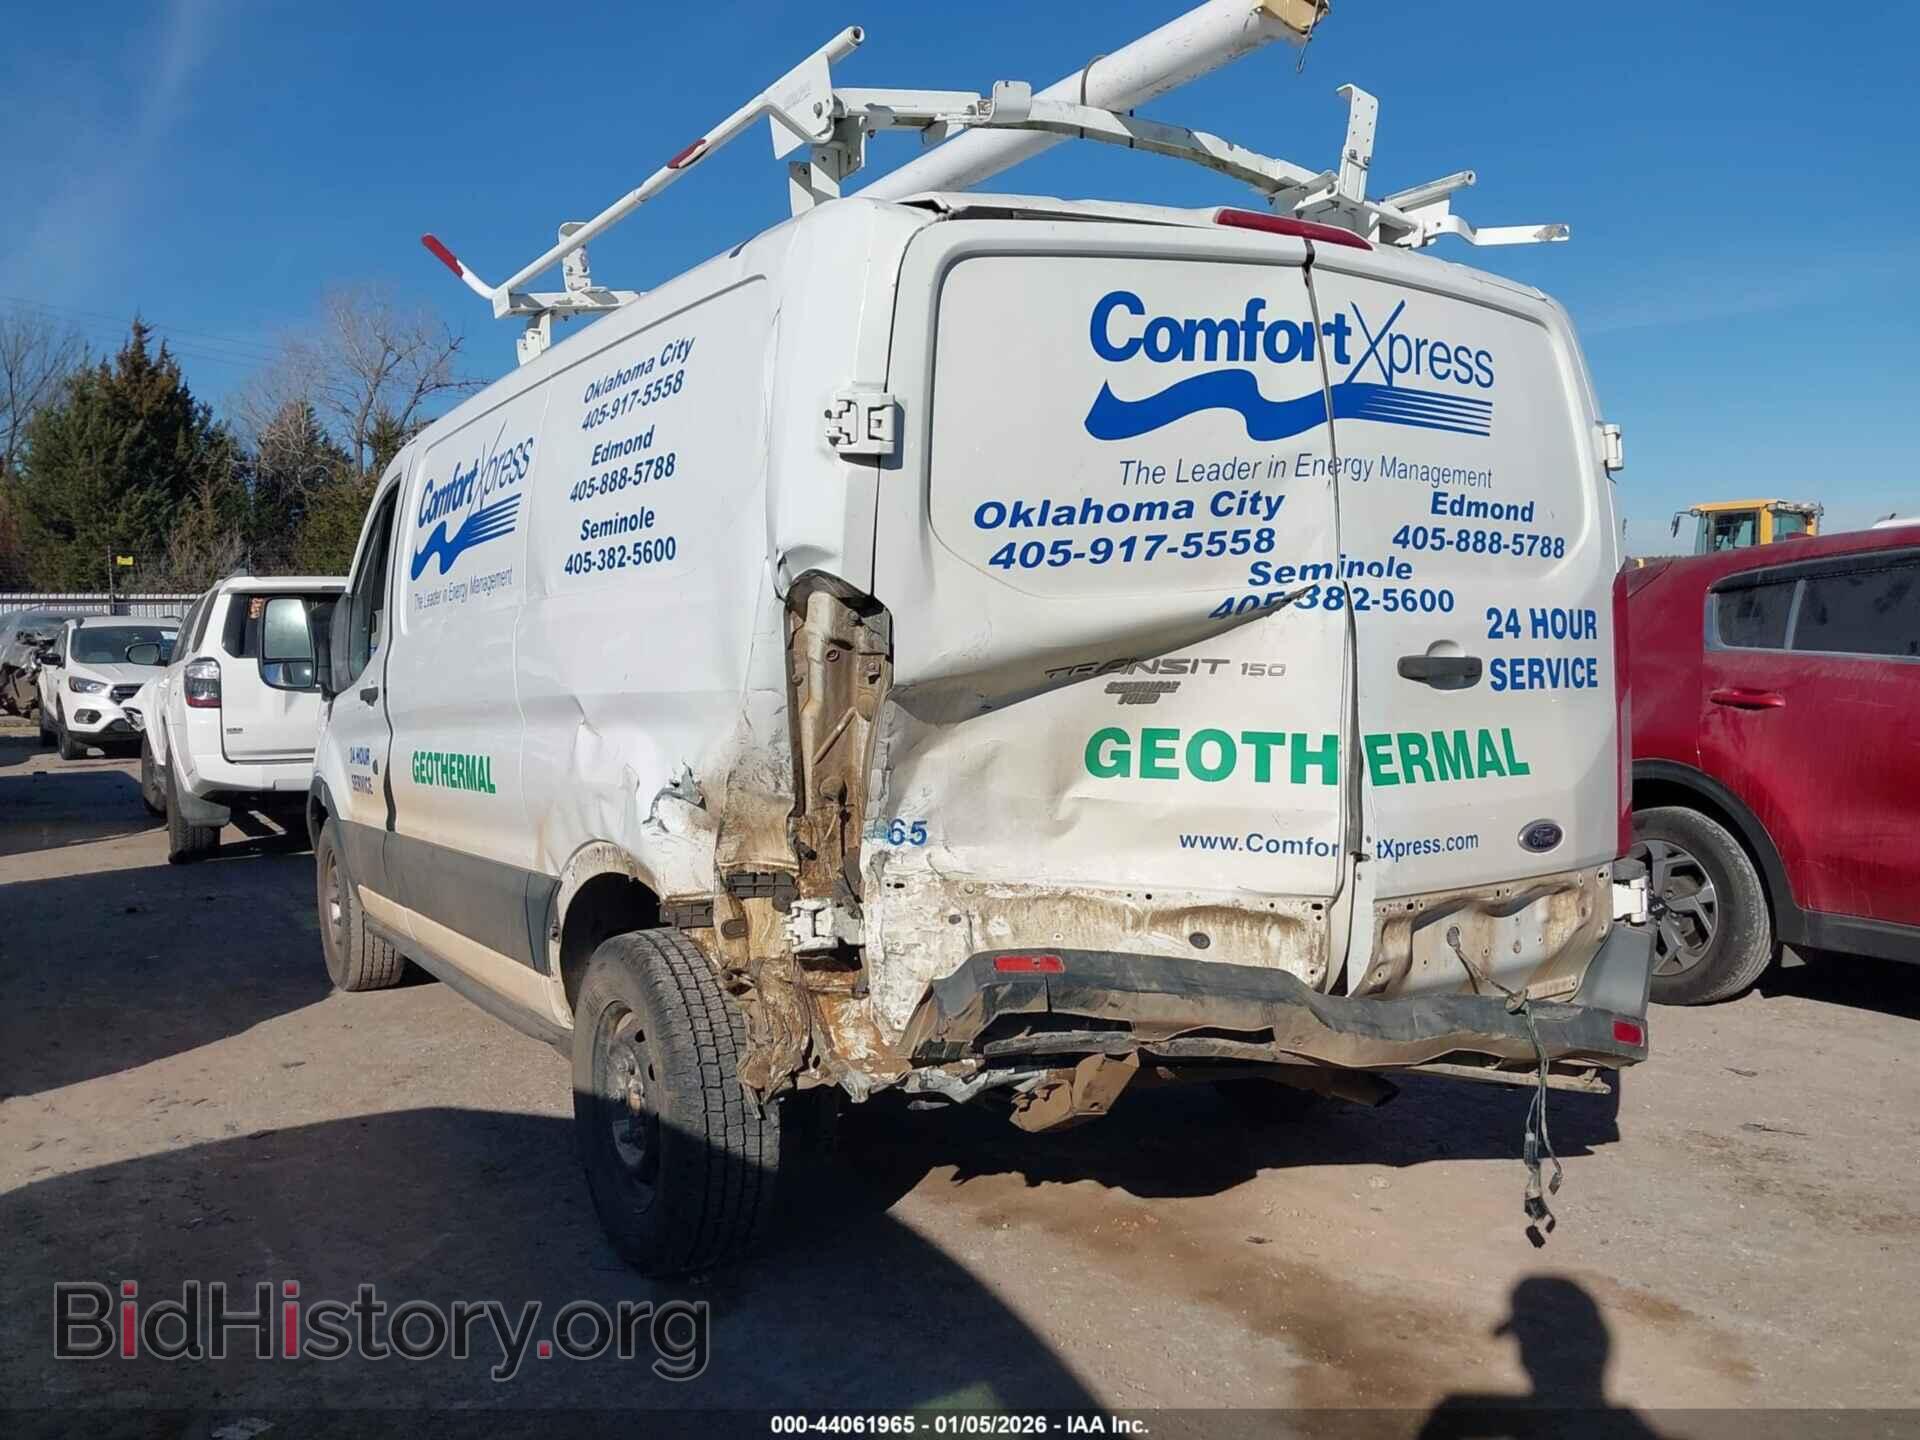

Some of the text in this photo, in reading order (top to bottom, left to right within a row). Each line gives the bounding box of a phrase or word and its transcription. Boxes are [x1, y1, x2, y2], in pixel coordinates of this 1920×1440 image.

[1090, 290, 1495, 388] ComfortXpress
[584, 336, 696, 404] Oklahoma City
[581, 369, 685, 432] 405-917-5558
[591, 424, 656, 466] Edmond
[418, 417, 534, 529] ComfortXpress
[569, 452, 676, 503] 405-888-5788
[1120, 453, 1493, 489] The Leader in Energy Management
[580, 506, 655, 541] Seminole
[974, 490, 1286, 529] Oklahoma City
[1431, 491, 1535, 523] Edmond
[564, 536, 677, 576] 405-382-5600
[988, 527, 1276, 570] 405-917-5558
[1392, 525, 1565, 559] 405-888-5788
[1248, 554, 1413, 586] Seminole
[1486, 607, 1597, 640] 24 HOUR
[1044, 657, 1286, 679] TRANSIT 150
[1489, 657, 1599, 691] SERVICE
[412, 750, 496, 794] GEOTHERMAL
[1084, 727, 1531, 787] GEOTHERMAL
[888, 819, 928, 845] 65
[1179, 833, 1479, 862] www.ComfortXpress.com
